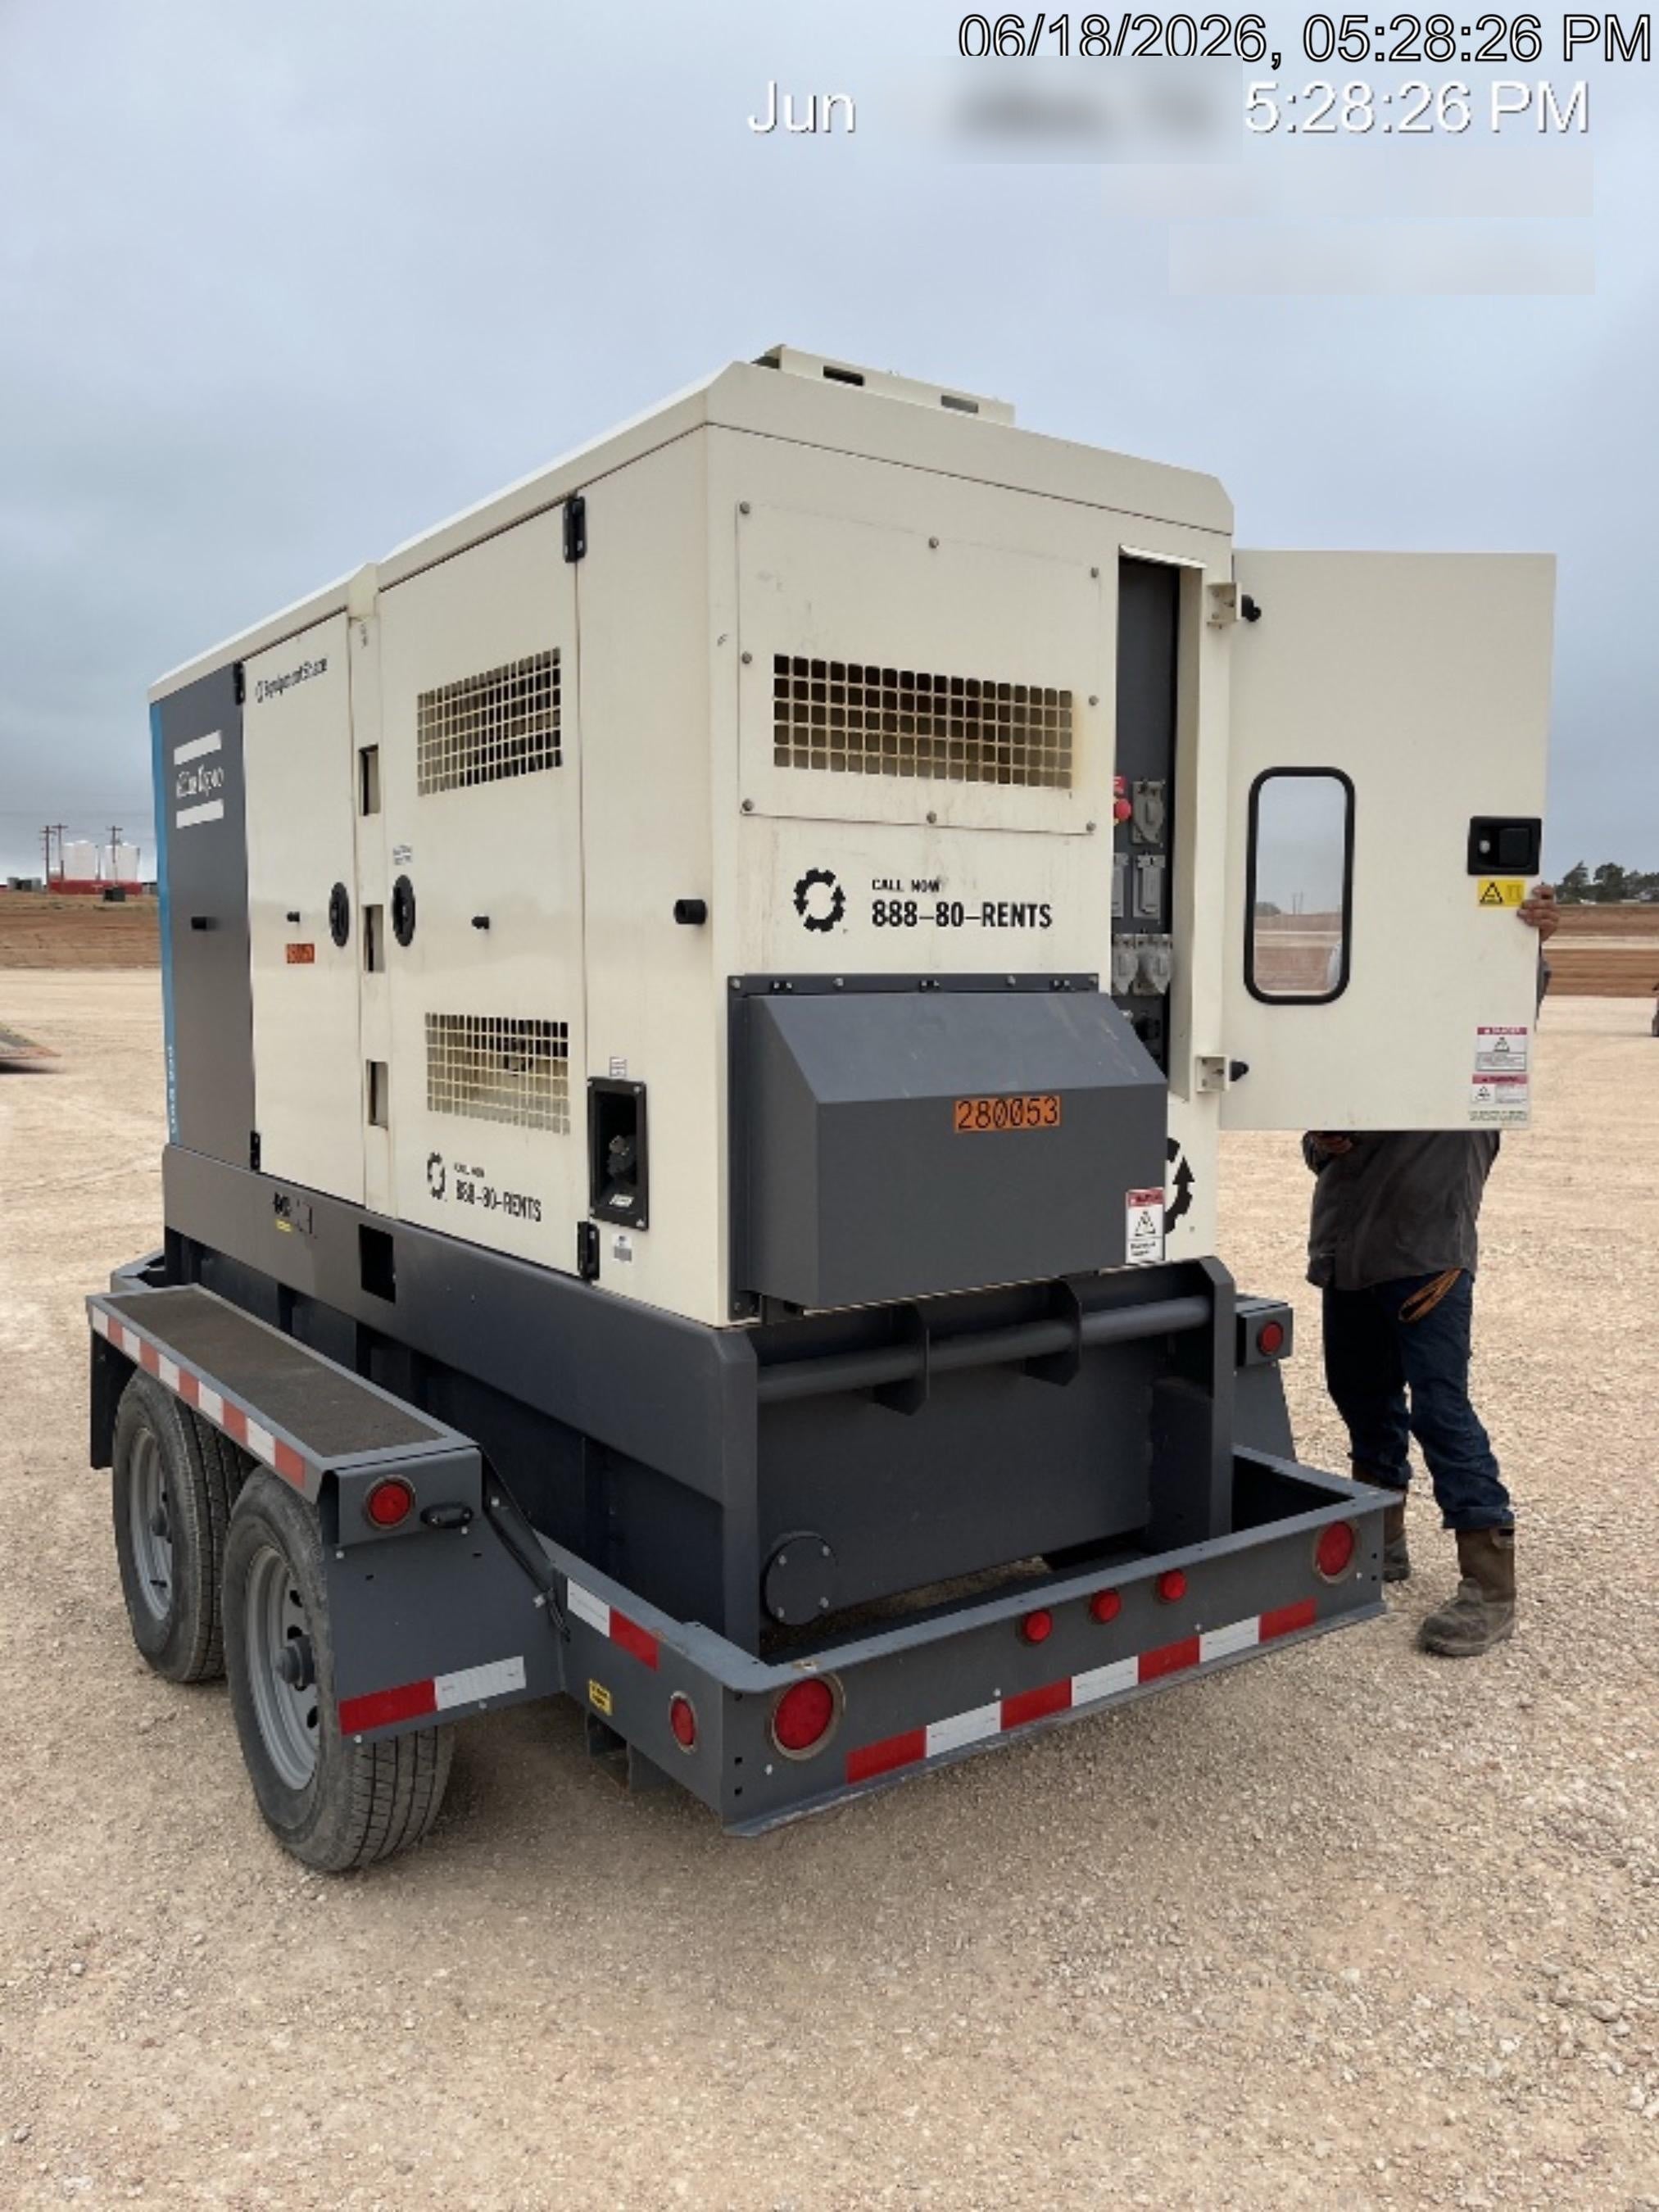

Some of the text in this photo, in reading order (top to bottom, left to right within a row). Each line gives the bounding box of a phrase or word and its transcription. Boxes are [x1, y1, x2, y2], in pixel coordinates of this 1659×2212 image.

[872, 879, 941, 893] CALL NOW
[872, 900, 1053, 929] 888-80-RENTS
[957, 1096, 1058, 1130] 280053
